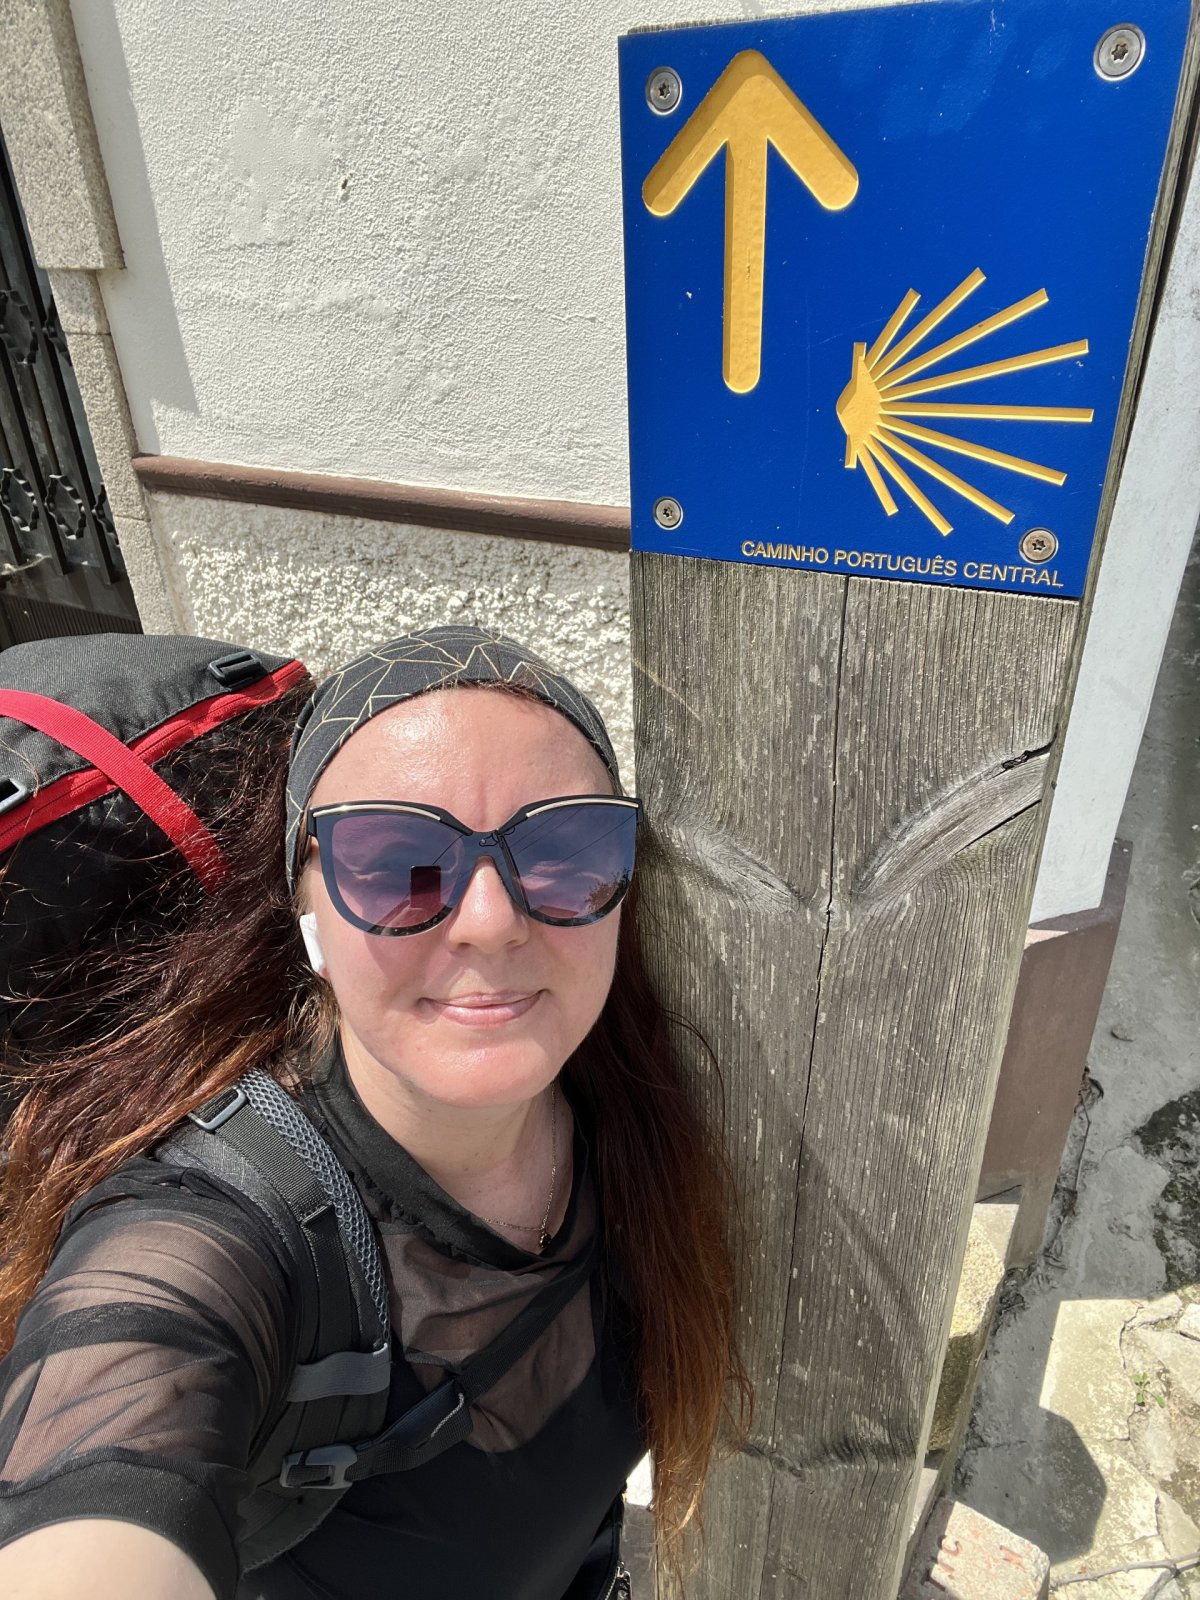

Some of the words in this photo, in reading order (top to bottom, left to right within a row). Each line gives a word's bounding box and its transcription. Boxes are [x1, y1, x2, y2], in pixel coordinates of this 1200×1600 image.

[741, 540, 829, 564] CAMINHO
[834, 550, 957, 577] PORTUGUÊS
[963, 561, 1064, 588] CENTRAL
